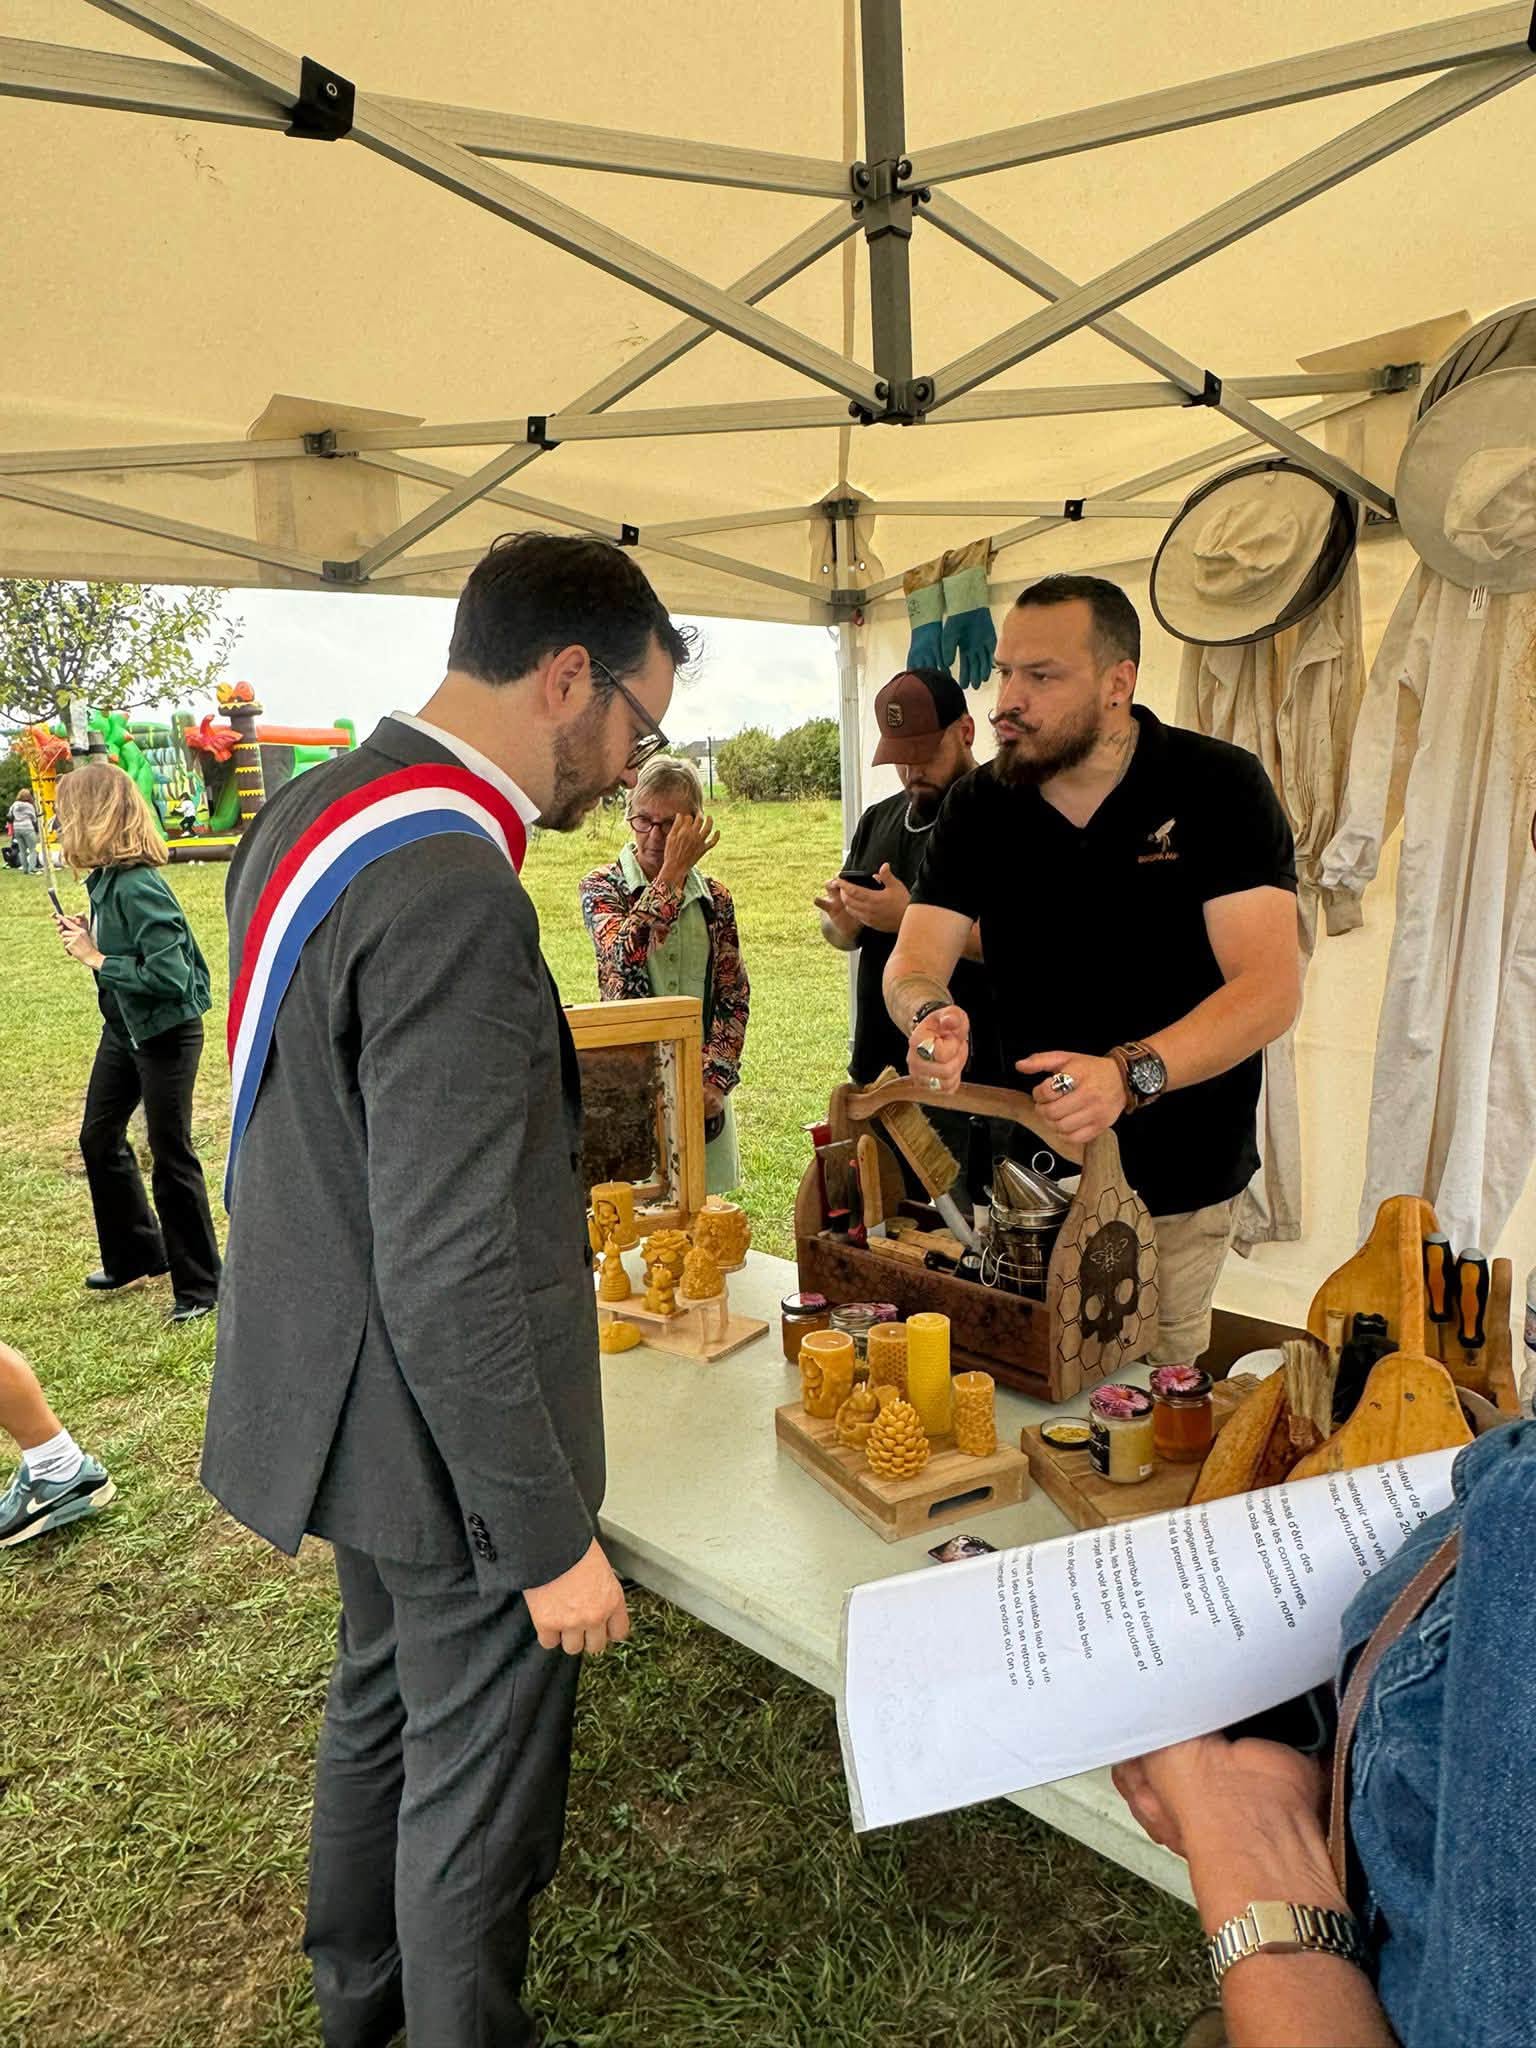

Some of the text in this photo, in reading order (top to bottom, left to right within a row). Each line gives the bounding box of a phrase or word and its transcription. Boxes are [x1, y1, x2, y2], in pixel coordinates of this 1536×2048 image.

[1380, 1473, 1405, 1519] Territoire
[1400, 1521, 1412, 1538] 20
[1409, 1494, 1421, 1509] de
[1248, 1513, 1260, 1530] cela
[1362, 1519, 1377, 1540] une
[1184, 1519, 1203, 1571] engagement
[1254, 1533, 1266, 1548] est
[1334, 1507, 1368, 1566] périurbains
[1095, 1558, 1103, 1568] de
[1126, 1547, 1141, 1587] contribué
[1272, 1529, 1283, 1544] les
[1278, 1547, 1307, 1609] communes,
[1300, 1553, 1314, 1574] des
[1097, 1570, 1107, 1587] voir
[1171, 1546, 1191, 1590] proximité
[1184, 1592, 1199, 1616] sont
[1257, 1550, 1282, 1598] possible,
[997, 1590, 1004, 1602] un
[1014, 1597, 1022, 1608] où
[1072, 1592, 1081, 1610] une
[1101, 1590, 1109, 1599] le
[1137, 1598, 1146, 1608] la
[1211, 1558, 1219, 1572] les
[1216, 1575, 1245, 1641] collectivités,
[1027, 1590, 1040, 1629] véritable
[1278, 1601, 1297, 1628] notre
[1000, 1604, 1010, 1636] endroit
[1077, 1613, 1086, 1631] très
[1115, 1570, 1127, 1609] bureaux
[1138, 1661, 1148, 1671] et
[1019, 1630, 1025, 1641] se
[1033, 1631, 1043, 1648] lieu
[1141, 1611, 1164, 1666] réalisation
[1004, 1639, 1013, 1651] où
[1081, 1634, 1091, 1659] belle
[1006, 1653, 1015, 1670] l'on
[1020, 1644, 1035, 1689] retrouve,
[1038, 1652, 1047, 1664] de
[1009, 1673, 1017, 1685] se
[1042, 1667, 1052, 1683] vie
